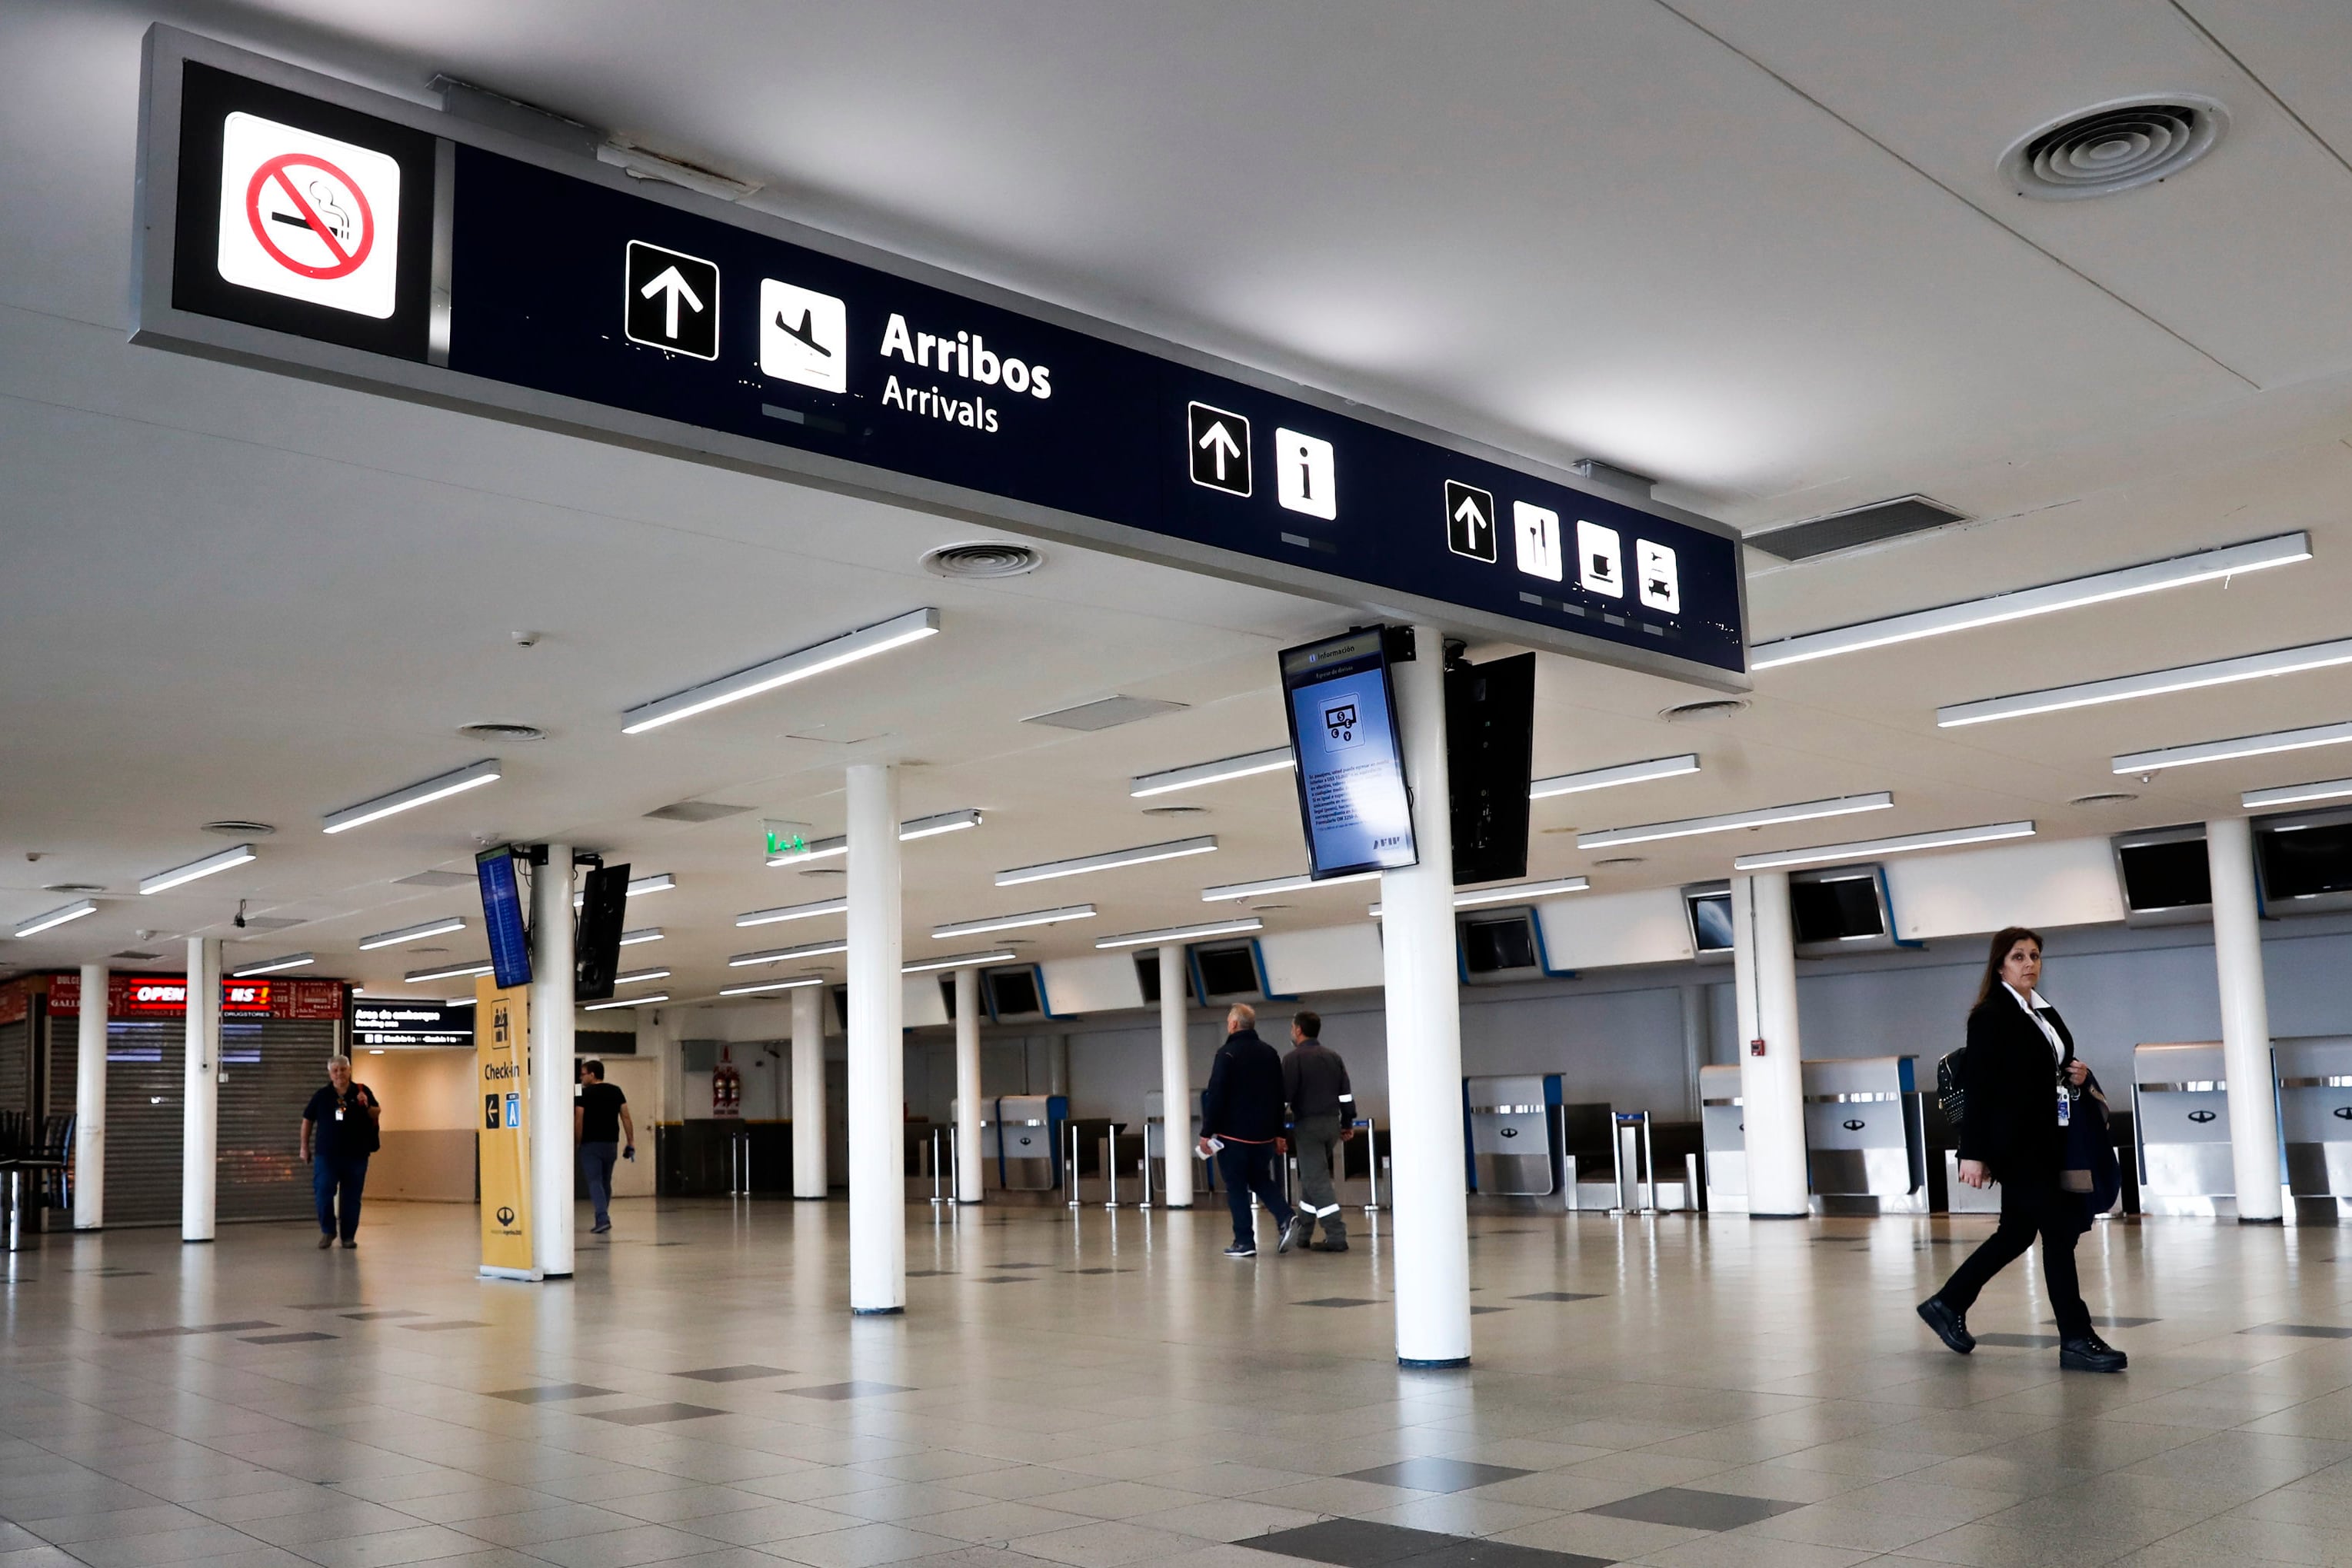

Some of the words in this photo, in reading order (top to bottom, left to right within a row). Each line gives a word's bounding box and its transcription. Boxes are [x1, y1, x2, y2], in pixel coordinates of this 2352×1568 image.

[880, 313, 1052, 400] Arribos
[881, 375, 999, 433] Arrivals
[1318, 646, 1355, 661] Información
[137, 987, 186, 1001] OPEN
[485, 1060, 520, 1080] Check-in
[509, 1103, 518, 1125] A
